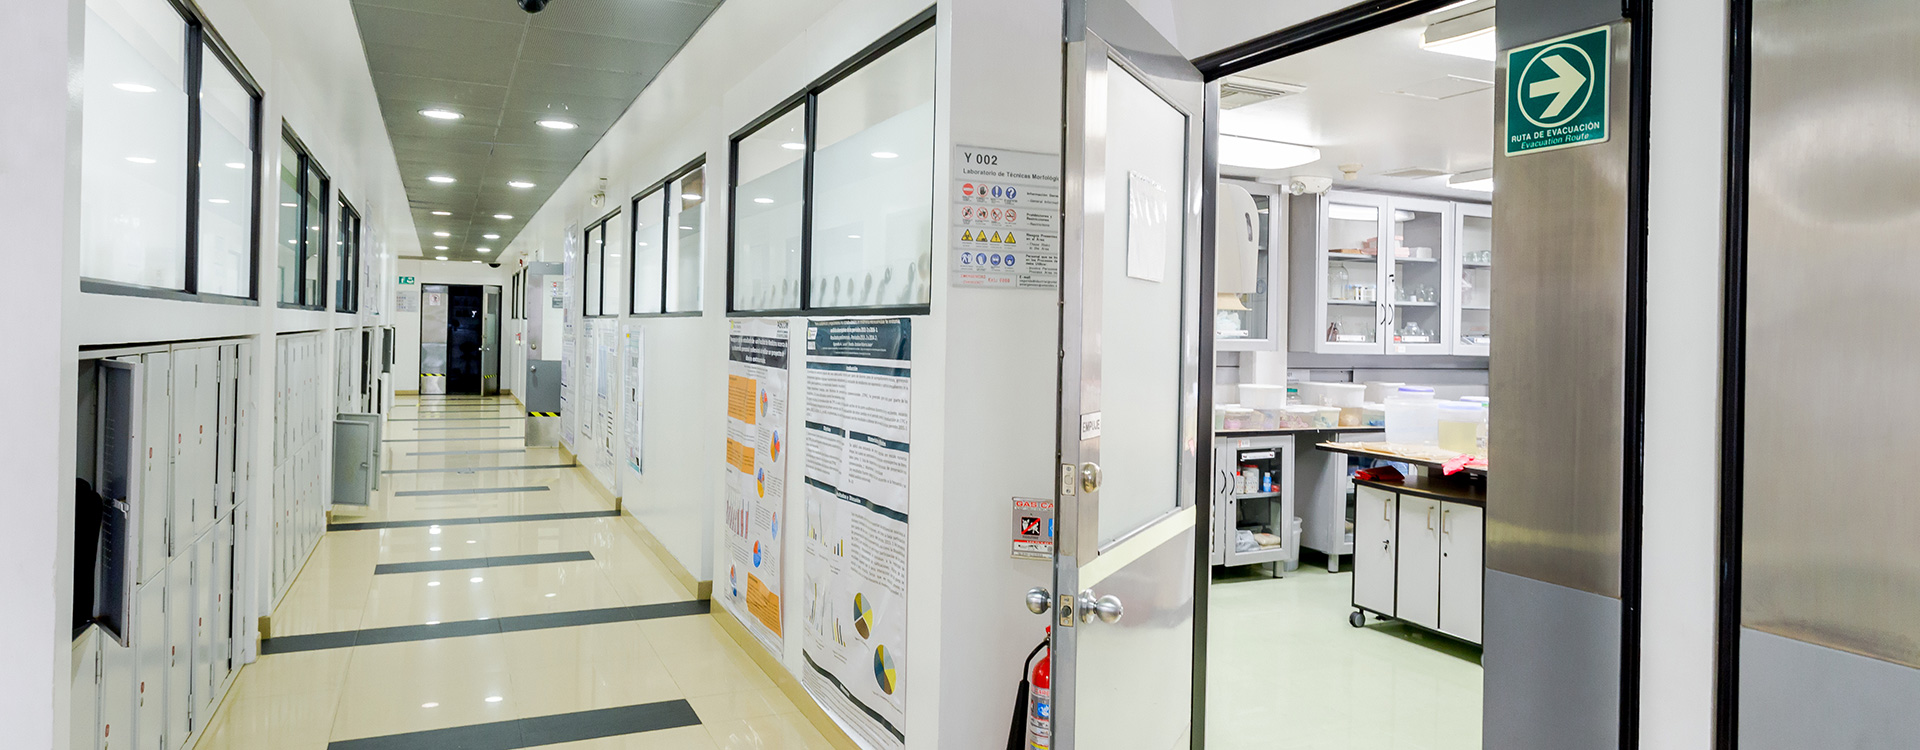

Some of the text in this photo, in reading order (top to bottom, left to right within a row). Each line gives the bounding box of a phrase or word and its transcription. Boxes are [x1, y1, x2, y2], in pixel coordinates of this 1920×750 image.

[1511, 121, 1600, 143] RUTA DE EVACUACIÓN
[1521, 132, 1590, 150] Evacuation Route
[964, 152, 998, 166] Y 002
[962, 168, 996, 176] Laboratorio
[1006, 171, 1030, 179] Técnicas
[1083, 419, 1100, 432] EMPUJE
